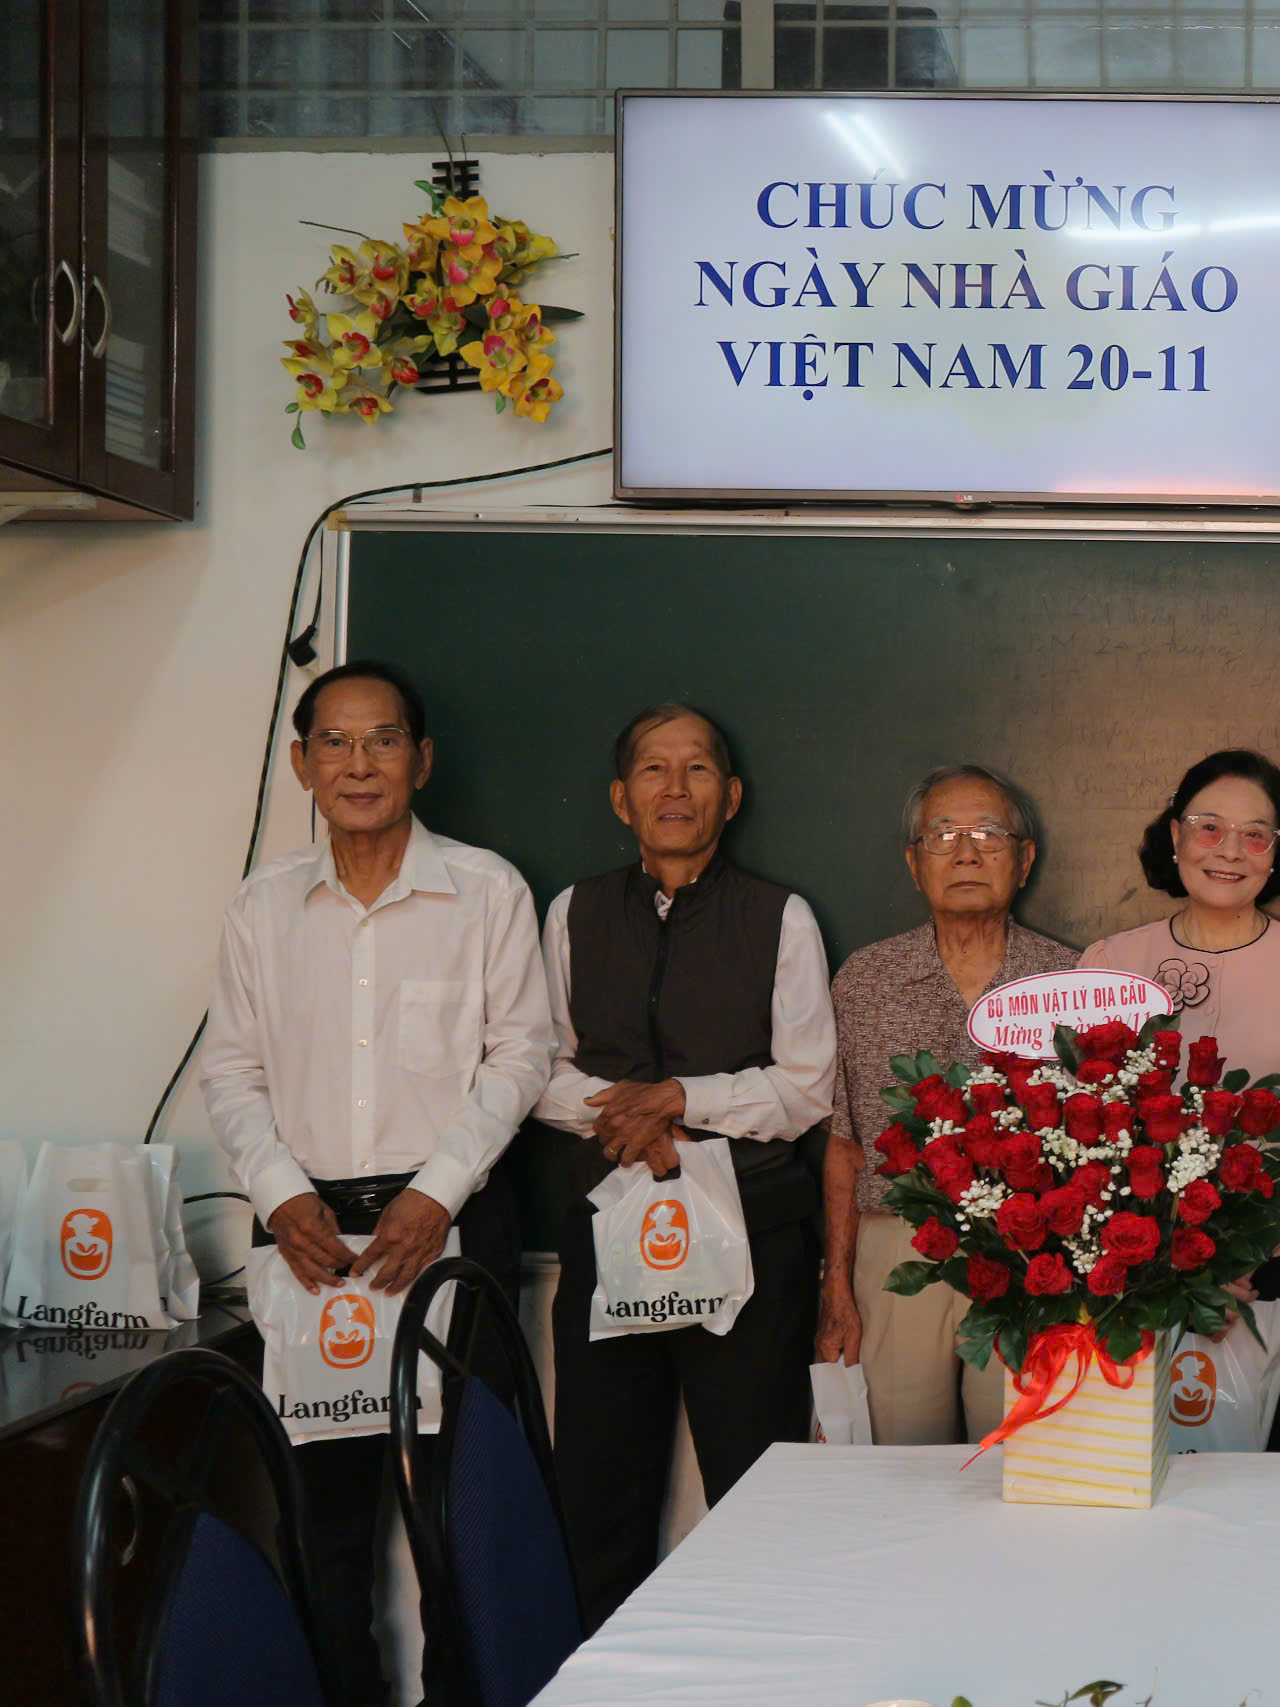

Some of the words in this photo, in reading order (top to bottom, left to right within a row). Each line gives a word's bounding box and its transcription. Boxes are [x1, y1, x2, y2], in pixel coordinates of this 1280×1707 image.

[755, 168, 947, 230] CHÚC
[965, 169, 1178, 231] MỪNG
[692, 246, 887, 308] NGÀY
[899, 248, 1047, 310] NHÀ
[1065, 250, 1240, 313] GIÁO
[715, 332, 875, 402] VIỆT
[890, 342, 1048, 391] NAM
[1065, 343, 1213, 393] 20-11
[988, 994, 1003, 1022] BỘ
[1009, 991, 1038, 1017] MÔN
[1043, 988, 1068, 1017] VẬT
[1073, 984, 1087, 1010] LÝ
[1094, 986, 1116, 1011] ĐỊA
[1120, 977, 1147, 1006] CẦU
[993, 1023, 1042, 1051] Mừng
[16, 1295, 151, 1329] Langfarm
[277, 1389, 424, 1423] Langfar
